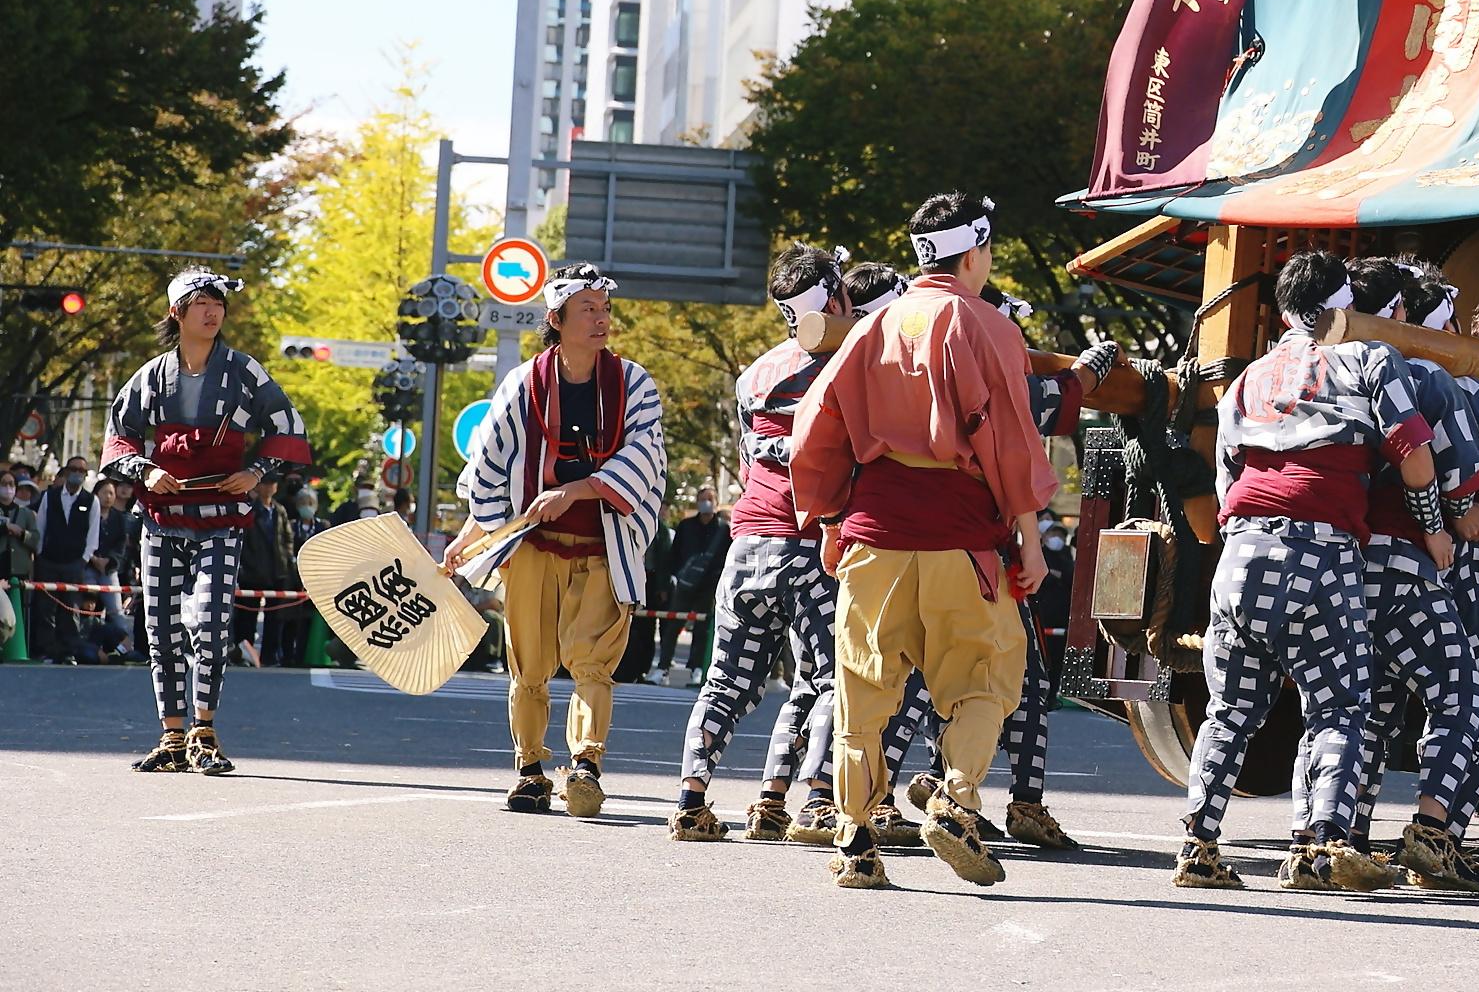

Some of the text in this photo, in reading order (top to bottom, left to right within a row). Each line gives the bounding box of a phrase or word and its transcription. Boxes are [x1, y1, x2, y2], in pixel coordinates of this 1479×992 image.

[1136, 46, 1172, 171] 東区筒井町
